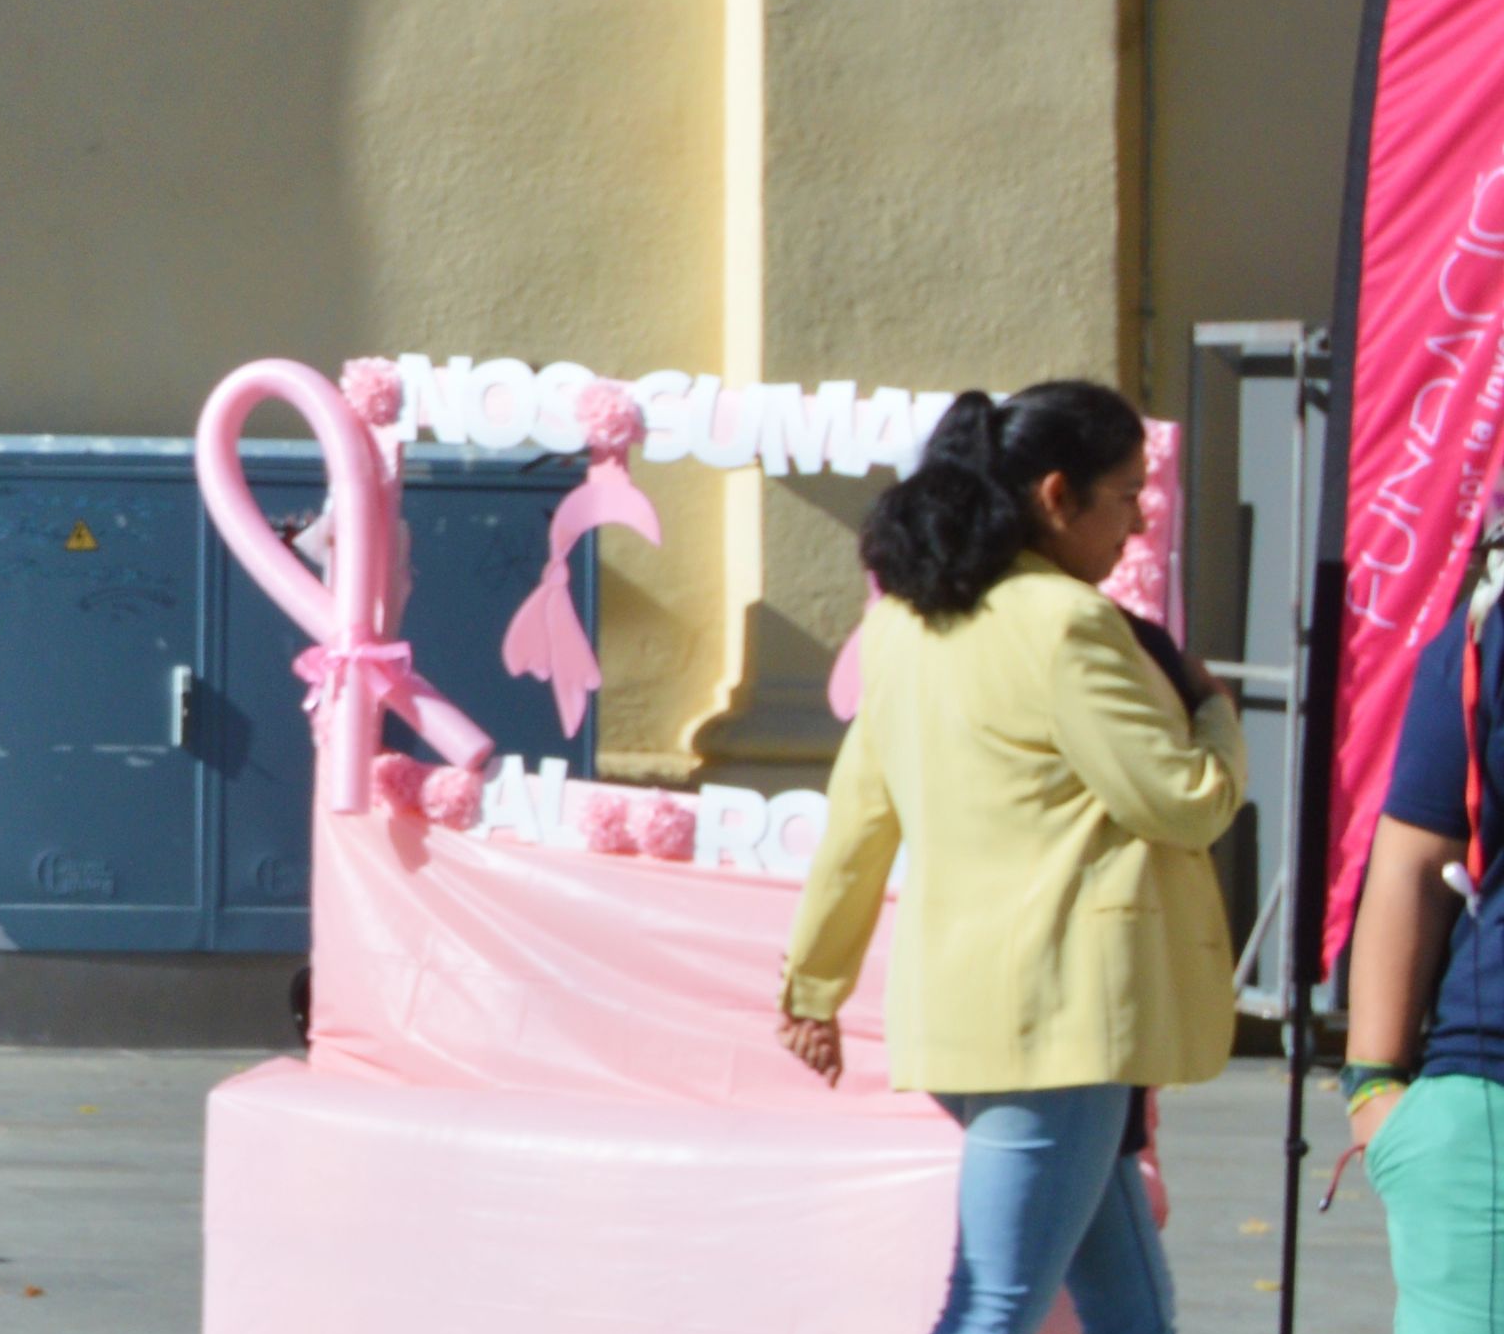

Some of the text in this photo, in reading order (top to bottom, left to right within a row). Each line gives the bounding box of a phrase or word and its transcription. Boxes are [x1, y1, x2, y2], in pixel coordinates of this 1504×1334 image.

[398, 353, 596, 453] NOS
[469, 754, 831, 881] AL RO
